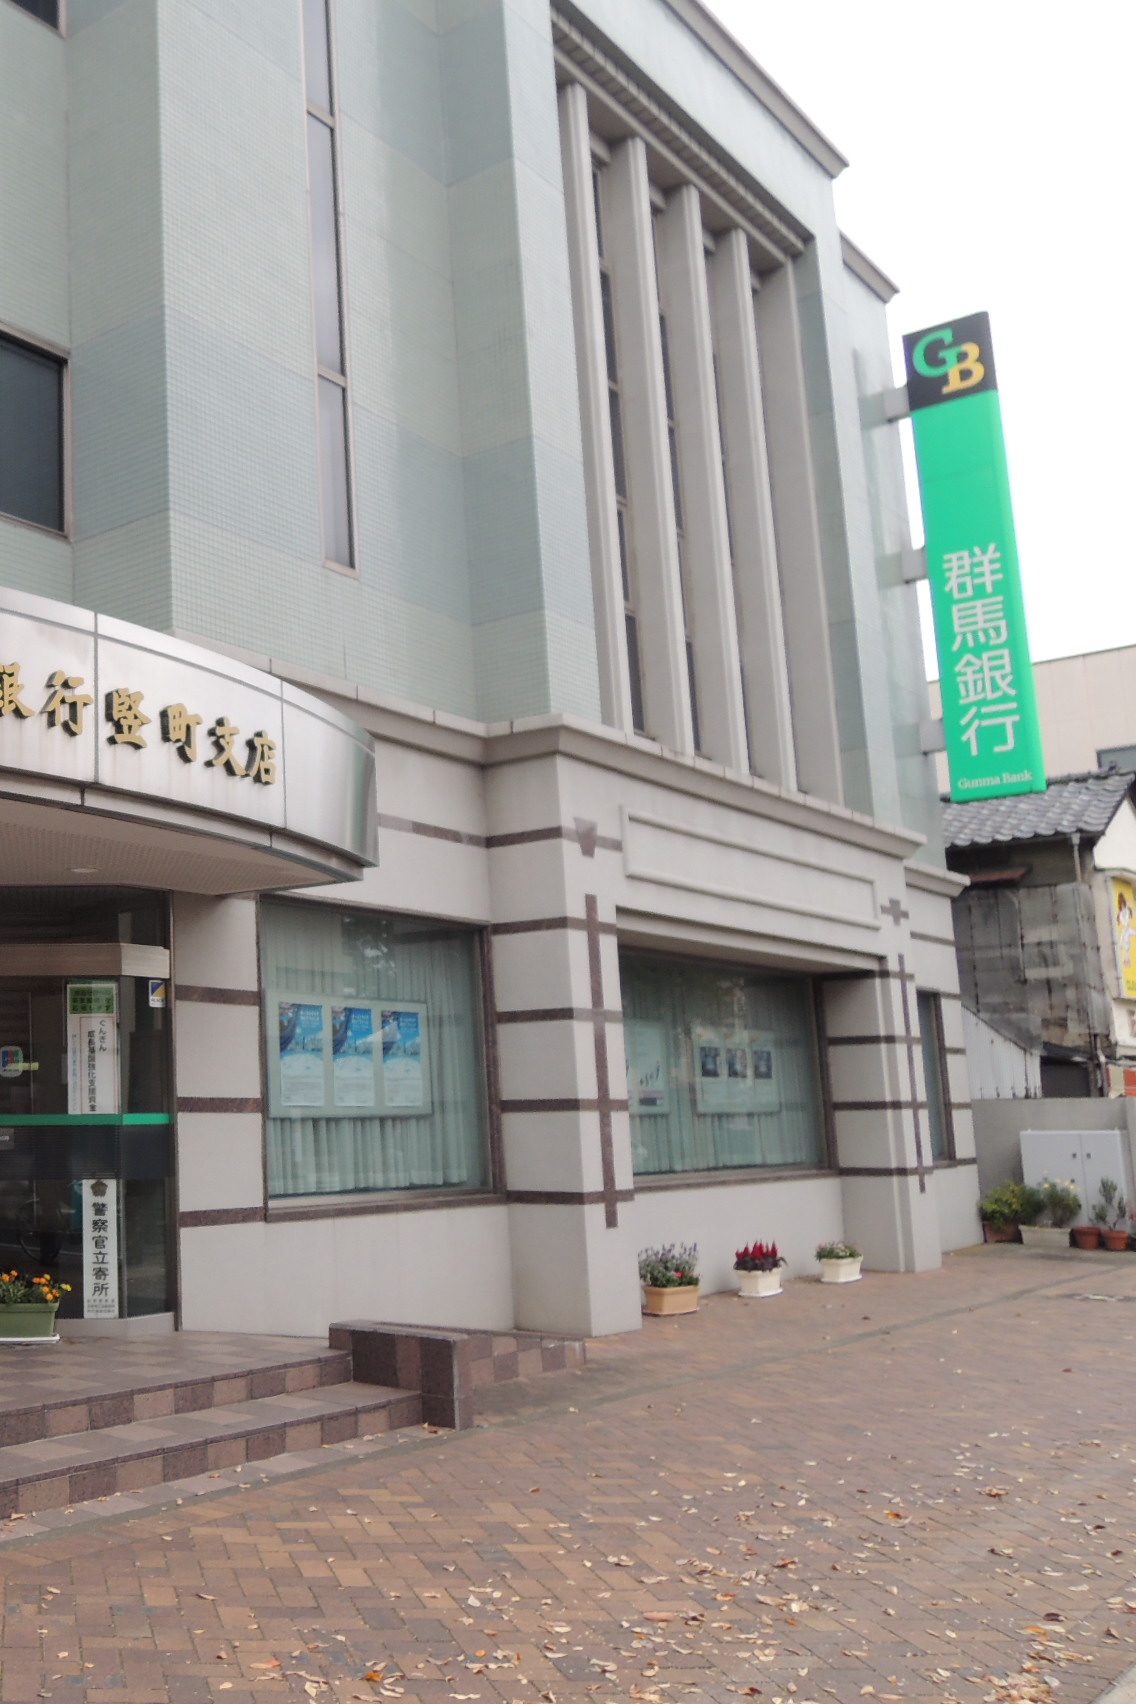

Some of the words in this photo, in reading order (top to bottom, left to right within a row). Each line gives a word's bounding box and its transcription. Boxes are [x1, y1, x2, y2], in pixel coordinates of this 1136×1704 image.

[942, 542, 1020, 757] 群馬銀行
[958, 776, 1002, 789] Gunma
[1002, 770, 1033, 784] Bank
[91, 1202, 109, 1297] 警察官立寄所
